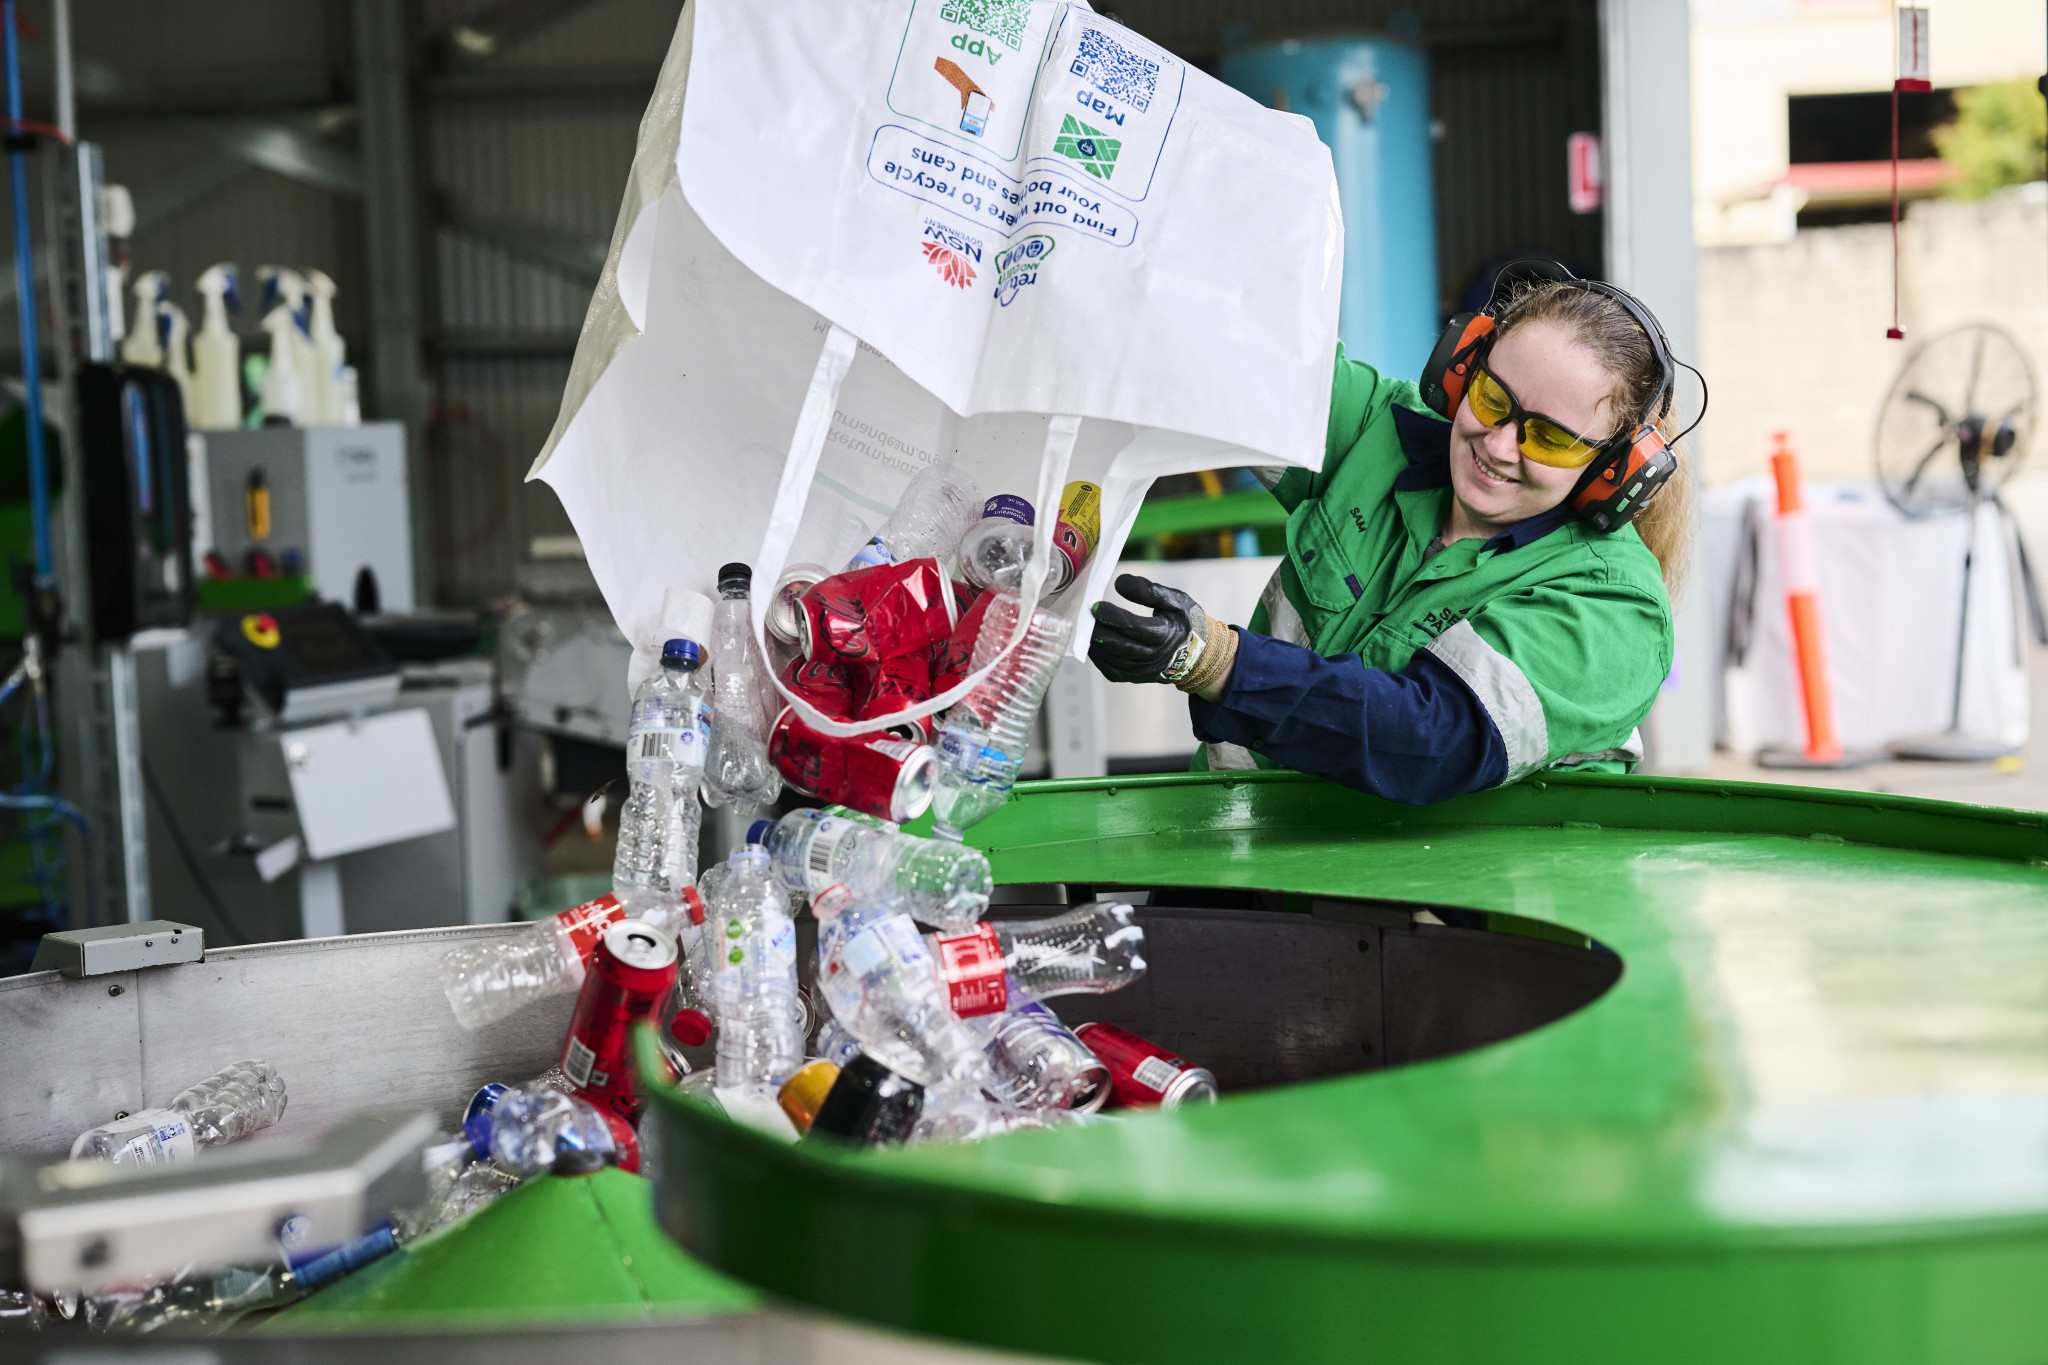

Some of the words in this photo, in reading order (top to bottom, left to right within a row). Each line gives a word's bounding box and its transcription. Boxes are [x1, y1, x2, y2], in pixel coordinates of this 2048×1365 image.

[951, 33, 1003, 66] App
[1076, 90, 1125, 127] Map
[911, 147, 956, 171] cans
[884, 161, 957, 198] recycle
[961, 167, 997, 190] and
[962, 192, 981, 212] to
[1033, 201, 1067, 215] out
[1057, 186, 1101, 213] your
[924, 216, 984, 248] GOVERNMENT
[1073, 213, 1118, 238] Find
[924, 226, 983, 263] NSW
[1349, 507, 1367, 533] SAM
